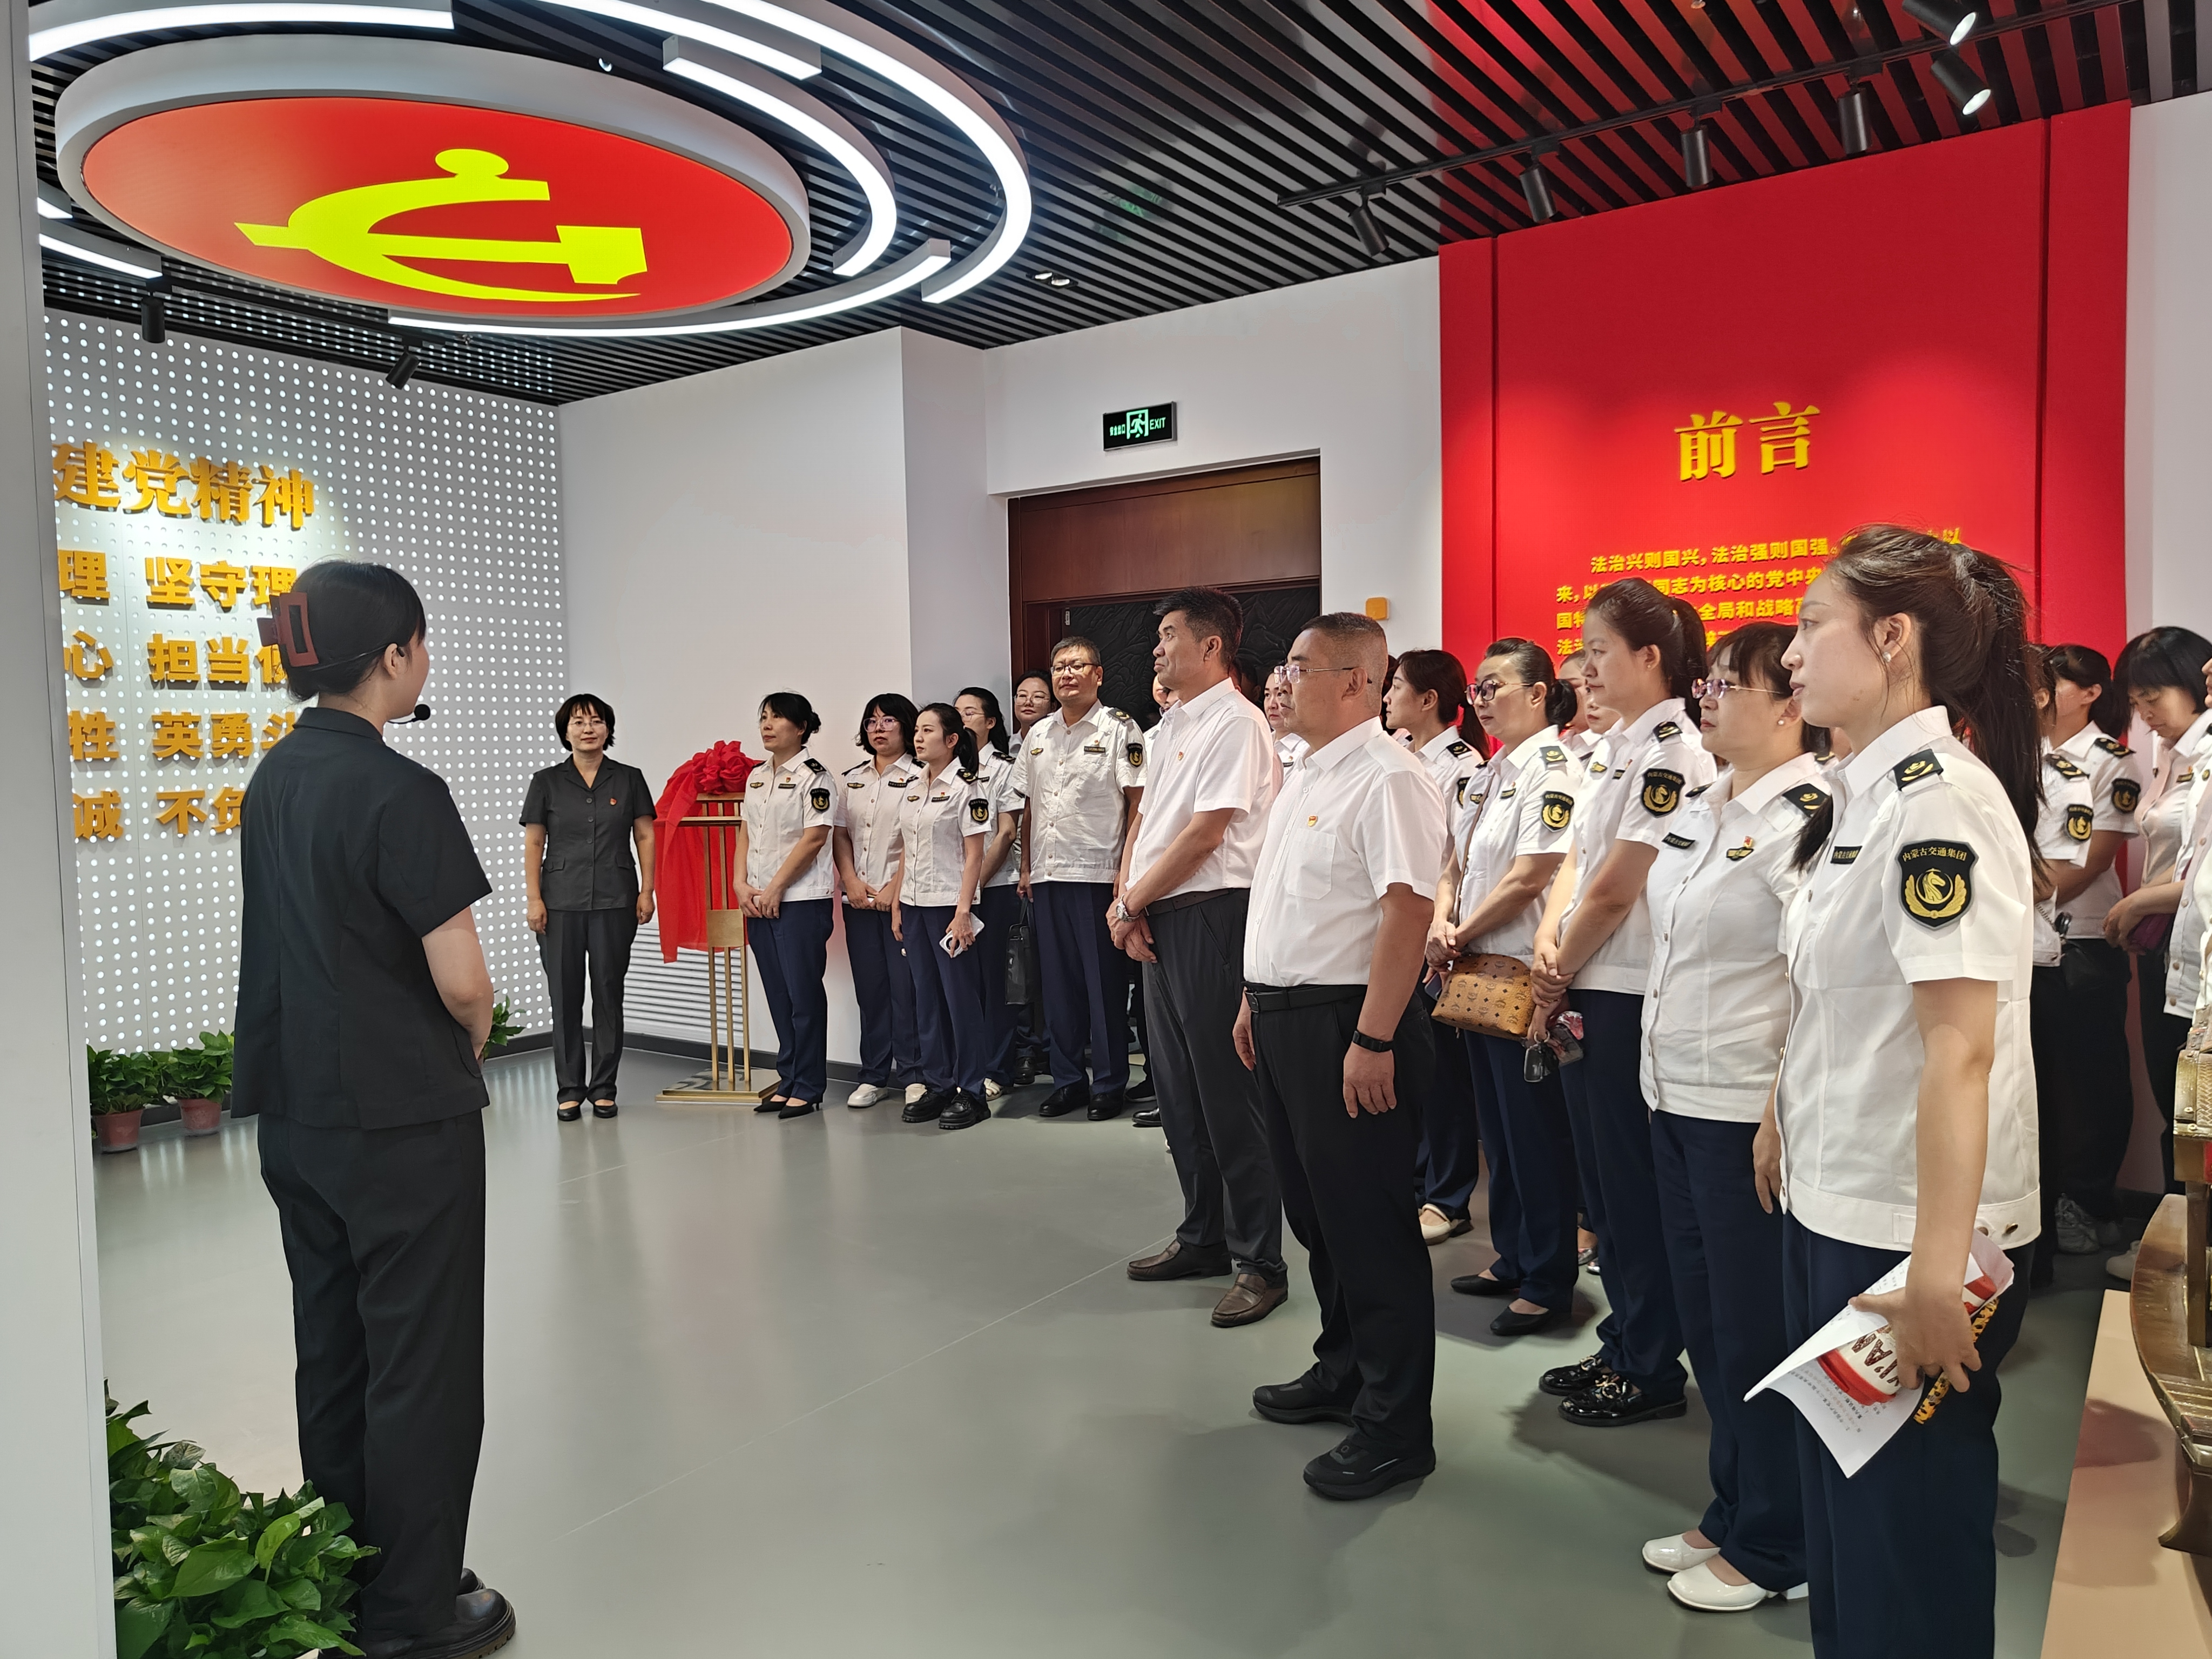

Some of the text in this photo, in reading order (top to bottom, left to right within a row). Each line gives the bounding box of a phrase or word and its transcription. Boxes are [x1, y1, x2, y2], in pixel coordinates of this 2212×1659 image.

[1150, 416, 1166, 430] EXIT
[1675, 402, 1820, 481] 前言
[52, 441, 315, 529] 建党精神
[58, 550, 110, 598] 理
[1902, 847, 1967, 862] 内蒙古交通集团
